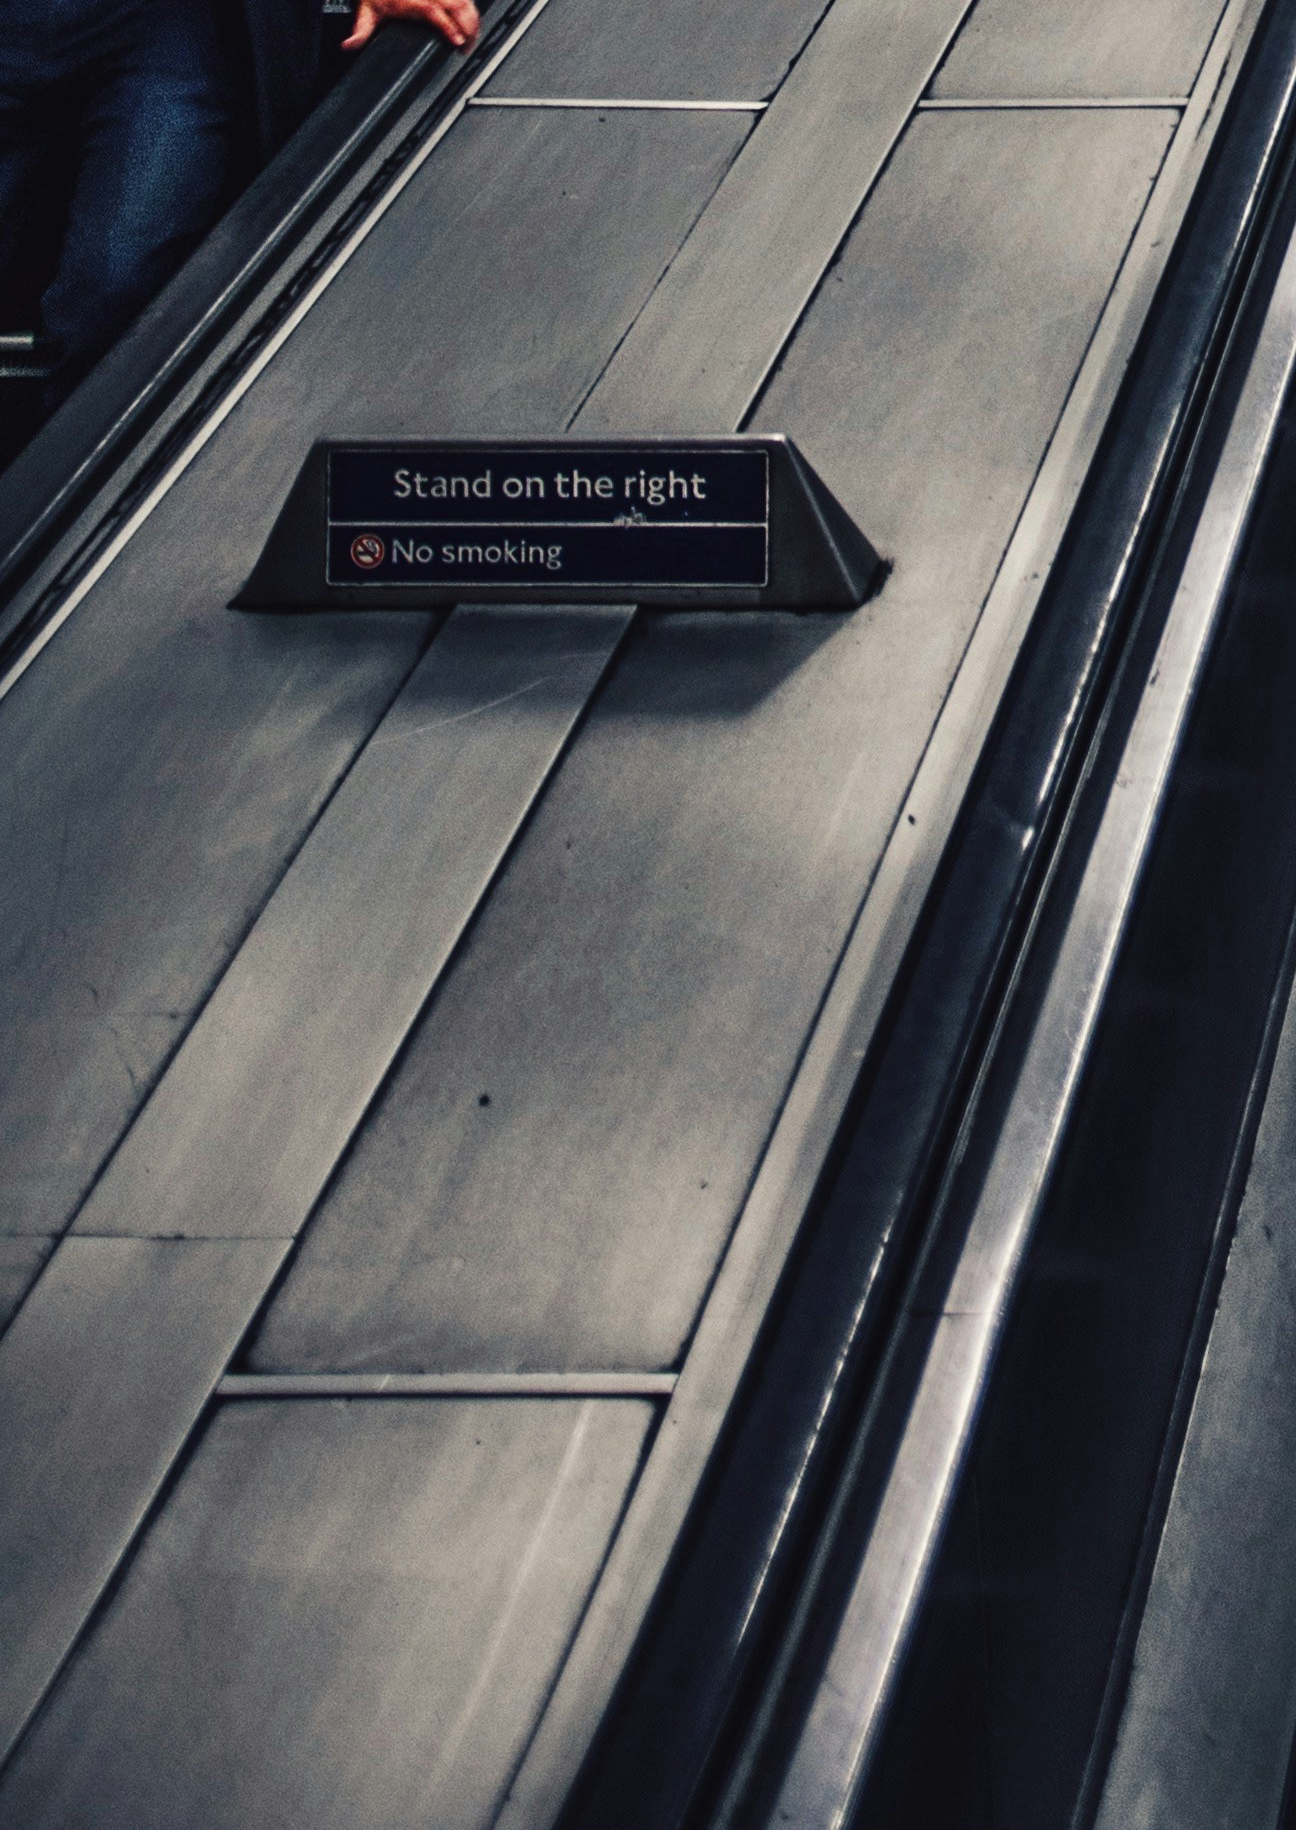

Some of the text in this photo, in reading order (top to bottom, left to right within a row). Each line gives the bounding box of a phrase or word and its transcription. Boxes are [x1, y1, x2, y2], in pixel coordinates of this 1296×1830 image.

[393, 468, 708, 506] Stand on the right
[391, 538, 564, 571] No smoking
